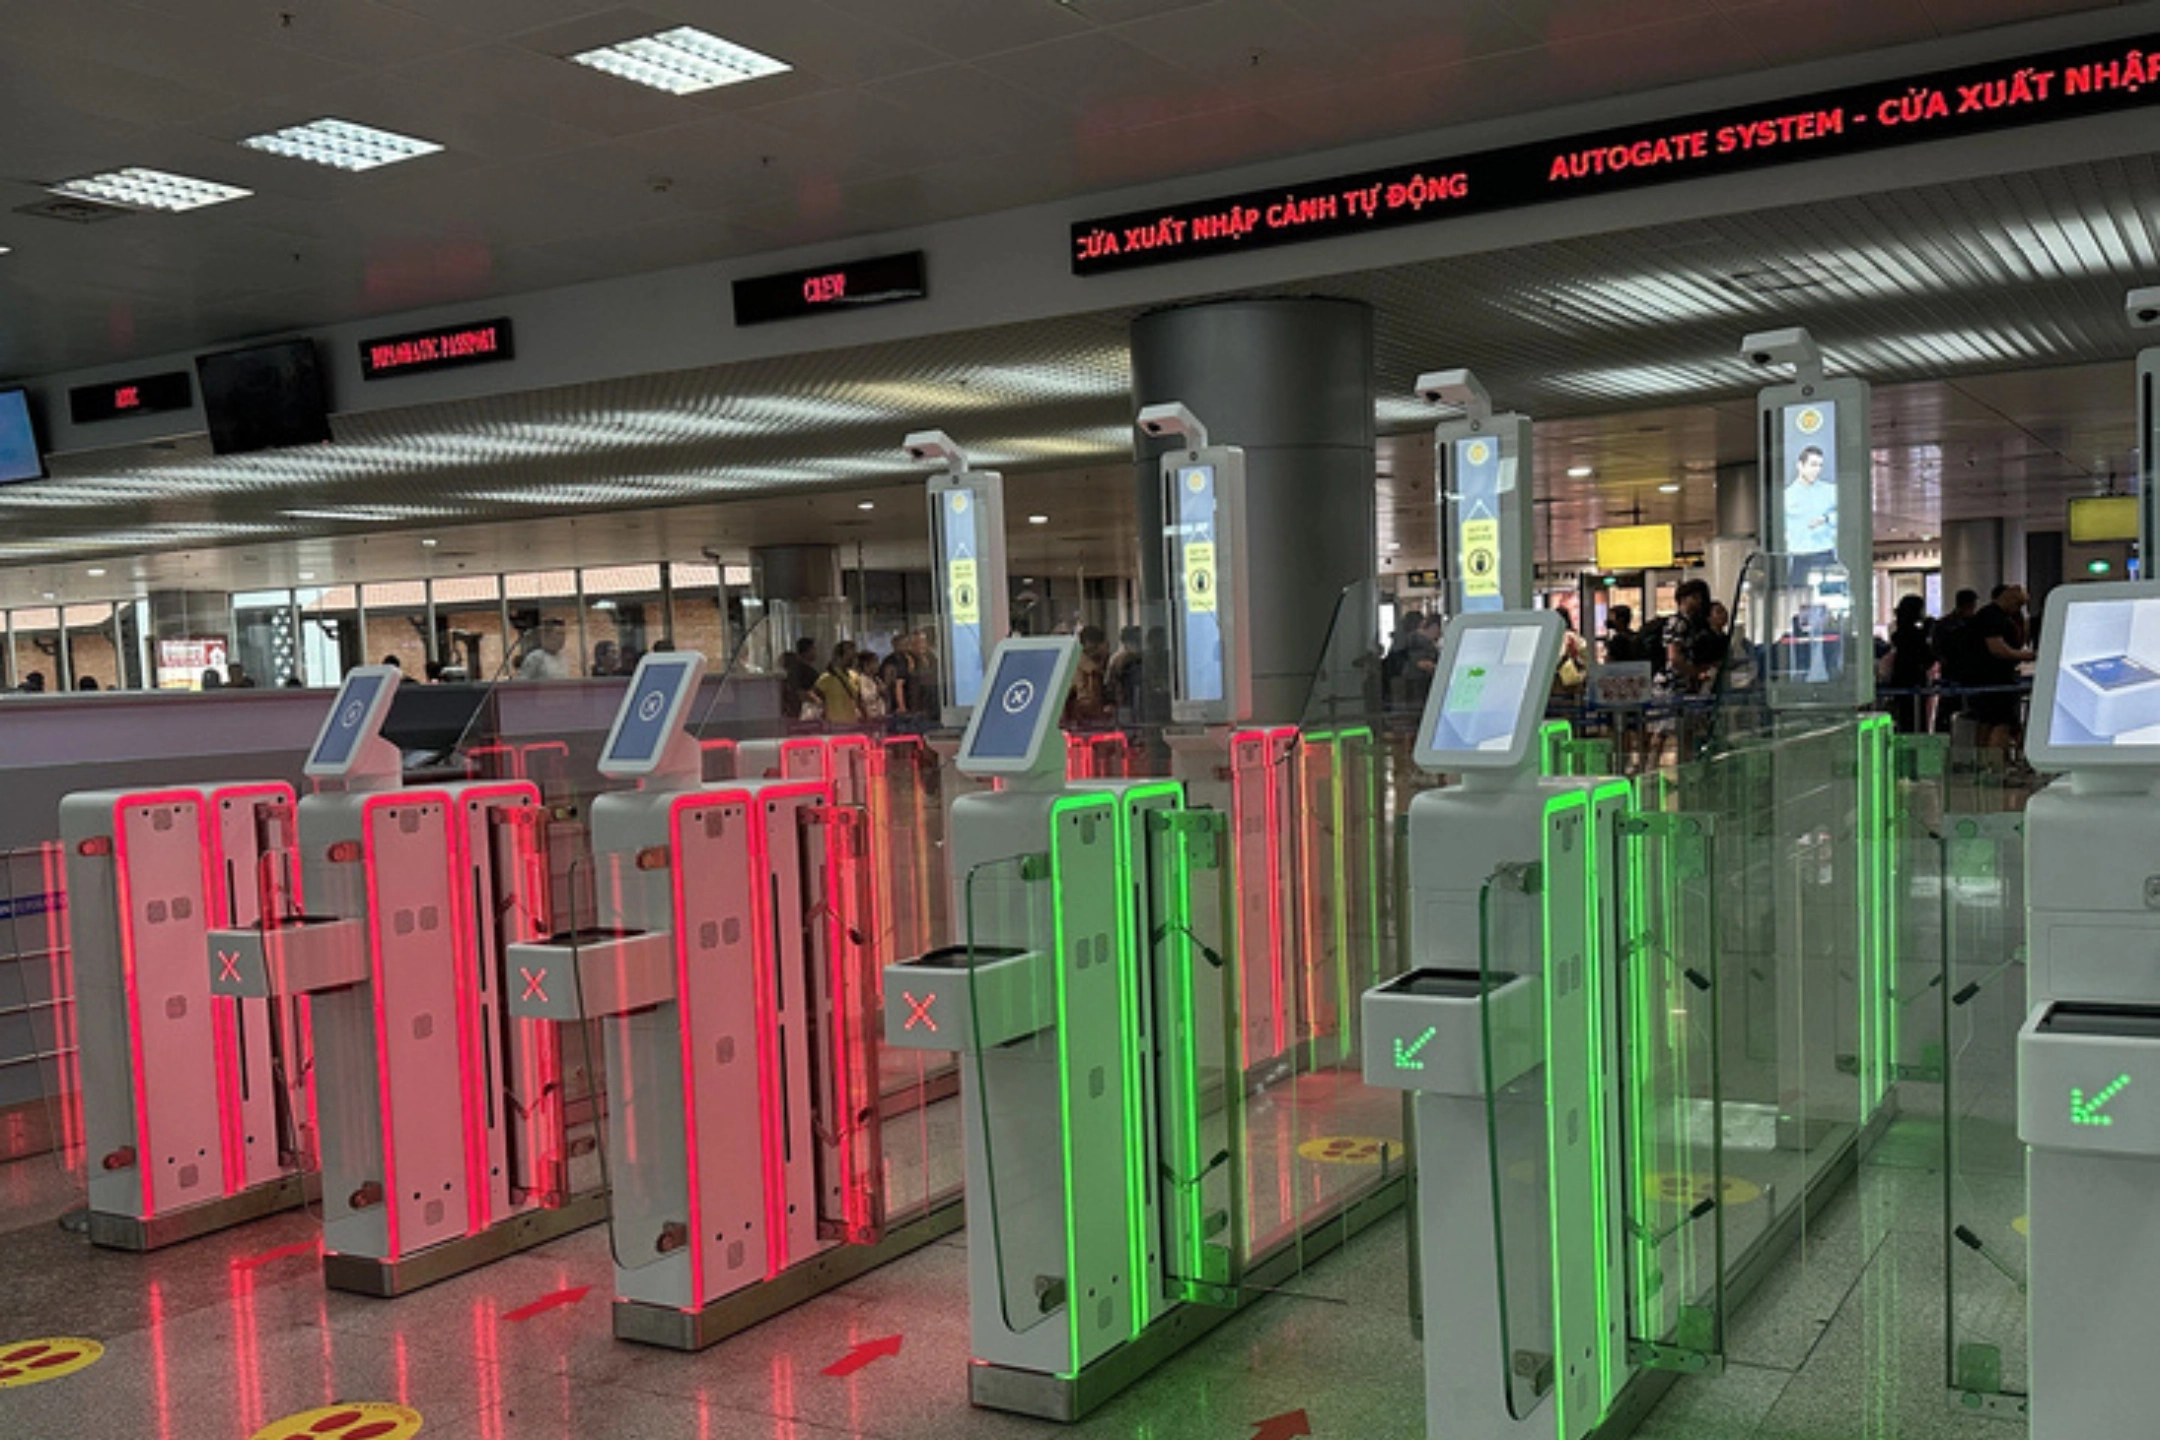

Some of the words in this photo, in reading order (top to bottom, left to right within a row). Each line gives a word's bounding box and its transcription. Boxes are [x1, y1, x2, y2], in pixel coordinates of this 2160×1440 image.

[1549, 130, 1707, 180] AUTOGATE
[1716, 107, 1843, 153] SYSTEM
[1877, 88, 1949, 126] CỬA
[1957, 67, 2056, 114] XUẤT
[1124, 215, 1187, 252] XUẤT
[1192, 205, 1261, 240] NHẬP
[1343, 182, 1383, 218] TỰ
[1385, 172, 1469, 210] ĐỘNG
